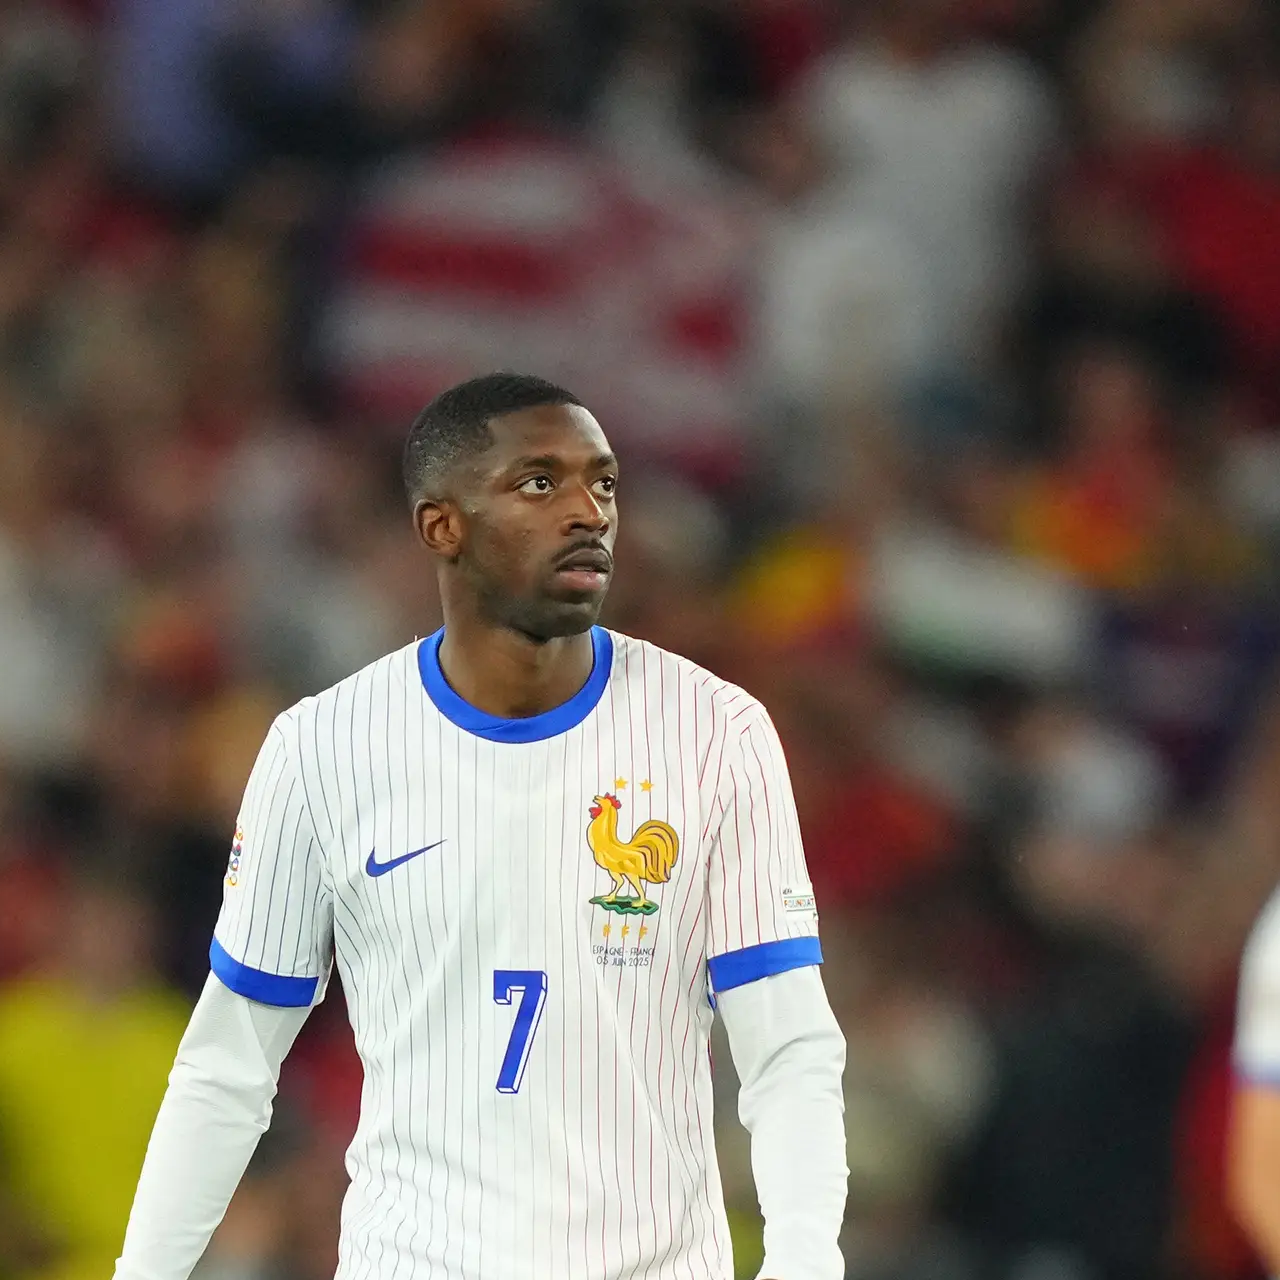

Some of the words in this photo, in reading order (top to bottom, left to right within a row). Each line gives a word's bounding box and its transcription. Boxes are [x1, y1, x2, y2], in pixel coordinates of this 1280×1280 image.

[593, 945, 623, 955] ESPAGNE
[628, 957, 649, 967] 2025
[493, 969, 548, 1094] 7
